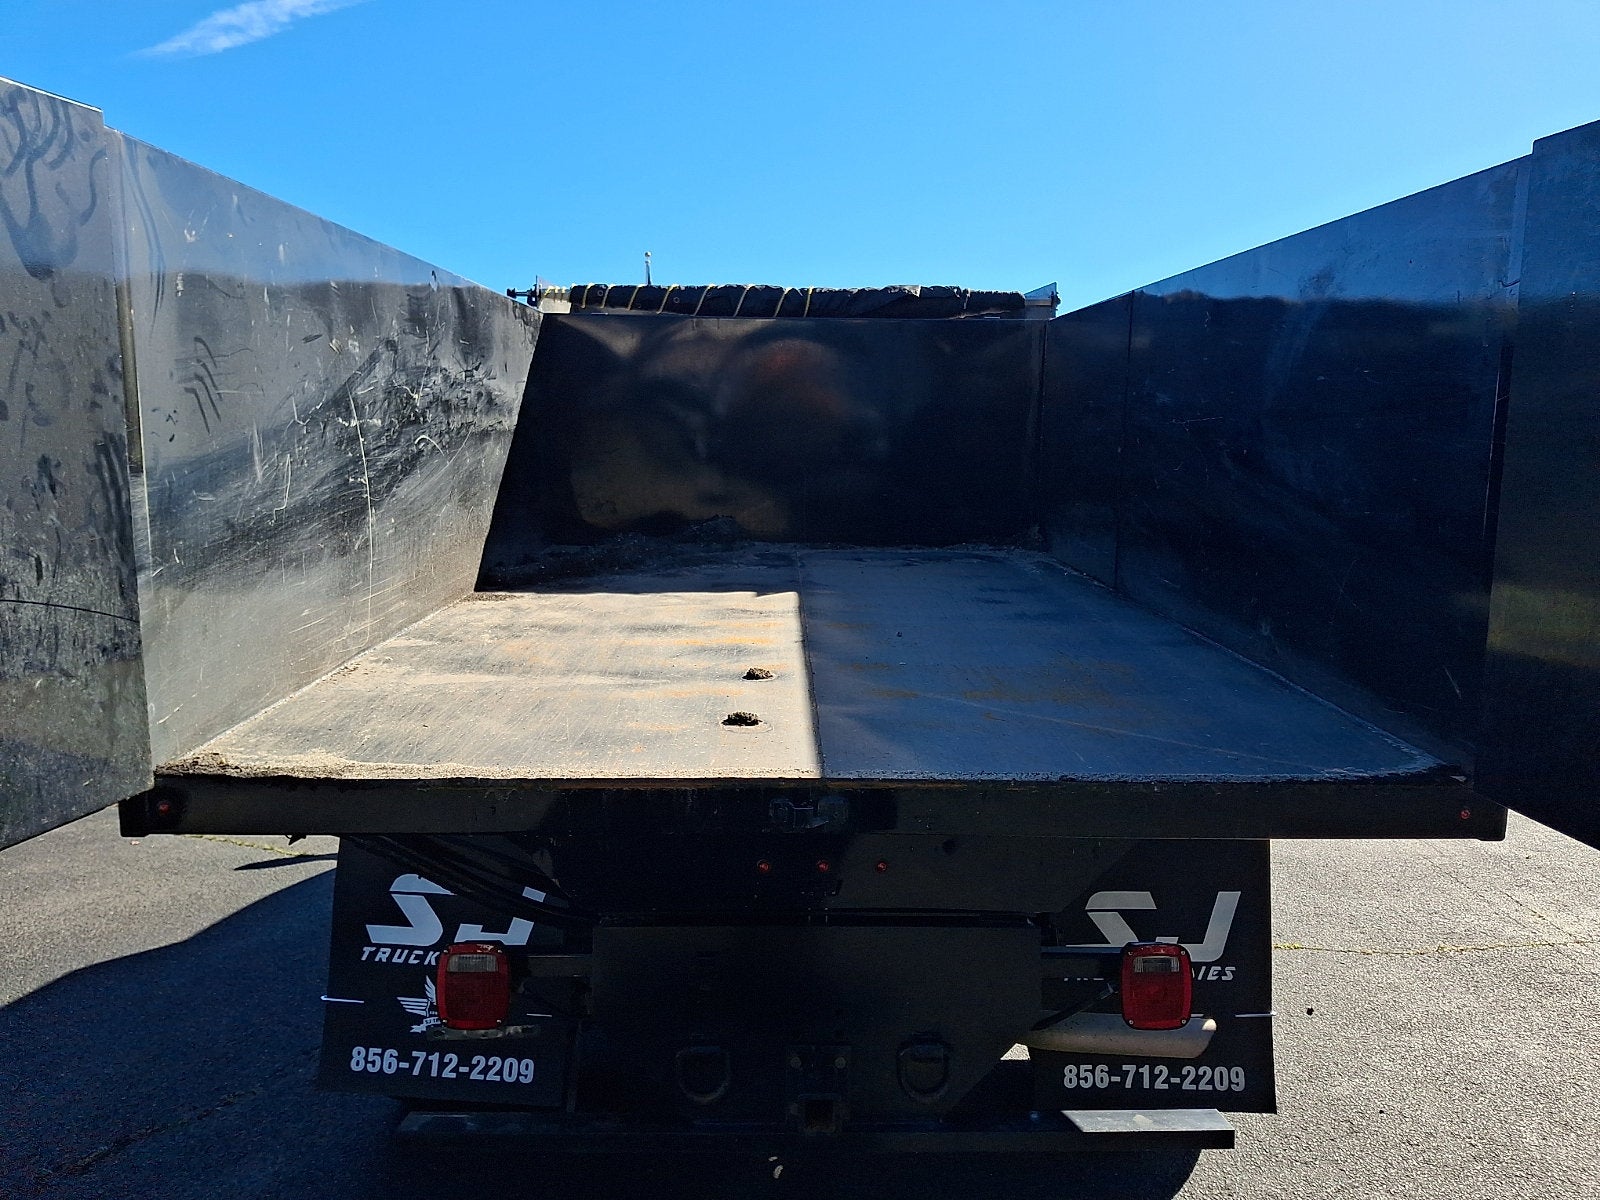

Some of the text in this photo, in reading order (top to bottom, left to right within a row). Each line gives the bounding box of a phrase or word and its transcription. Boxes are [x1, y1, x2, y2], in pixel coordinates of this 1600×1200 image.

[361, 946, 440, 966] TRUCK
[350, 1046, 535, 1084] 856-712-2209
[1063, 1064, 1246, 1092] 856-712-2209
